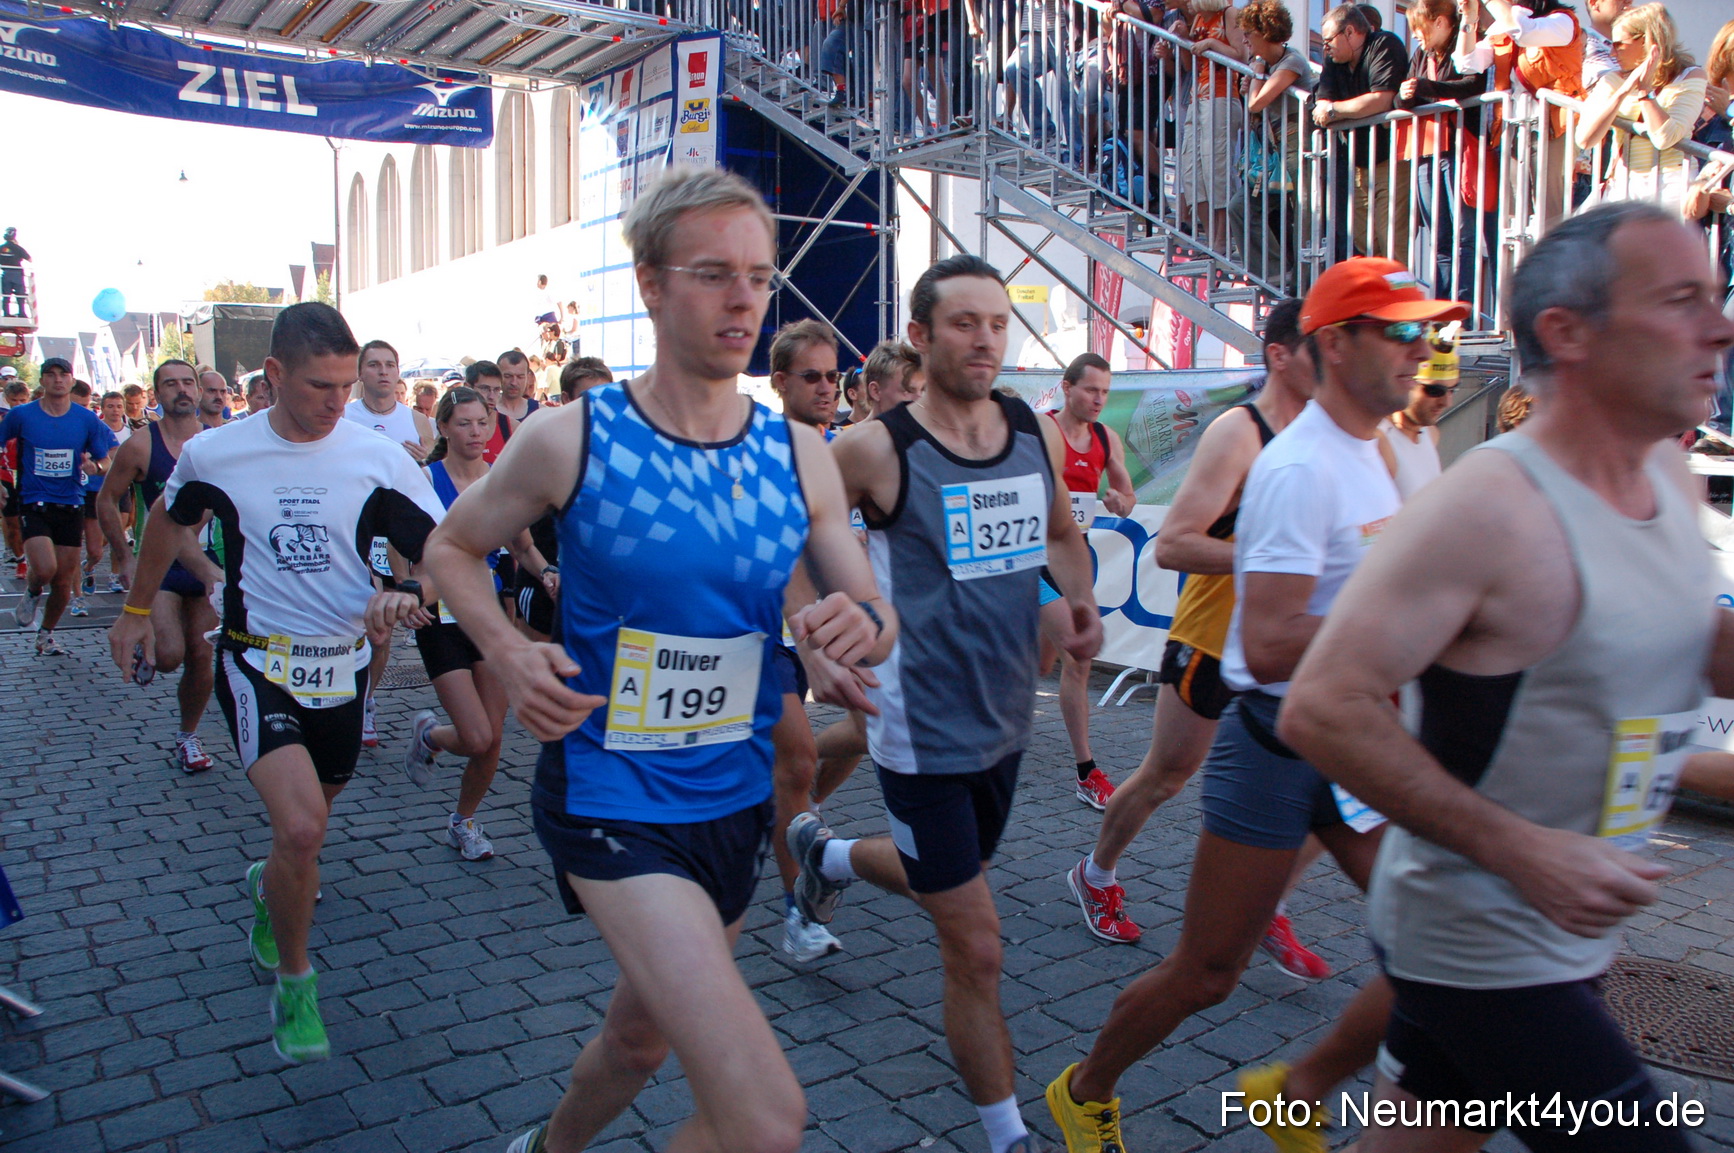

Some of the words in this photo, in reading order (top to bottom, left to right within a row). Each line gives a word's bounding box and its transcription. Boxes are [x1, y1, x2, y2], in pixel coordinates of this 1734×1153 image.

[177, 60, 318, 116] ZIEL
[412, 103, 477, 119] MIZUNO
[404, 123, 482, 133] www.mizunoeurope.com
[45, 461, 71, 470] 2645
[273, 486, 328, 495] orca
[973, 490, 1020, 511] Stefan
[853, 512, 862, 520] A
[953, 520, 967, 536] A
[978, 515, 1041, 551] 3272
[291, 644, 352, 658] Alexander
[657, 648, 722, 671] Oliver
[270, 660, 283, 673] A
[291, 666, 335, 688] 941
[620, 676, 639, 696] A
[658, 686, 727, 720] 199
